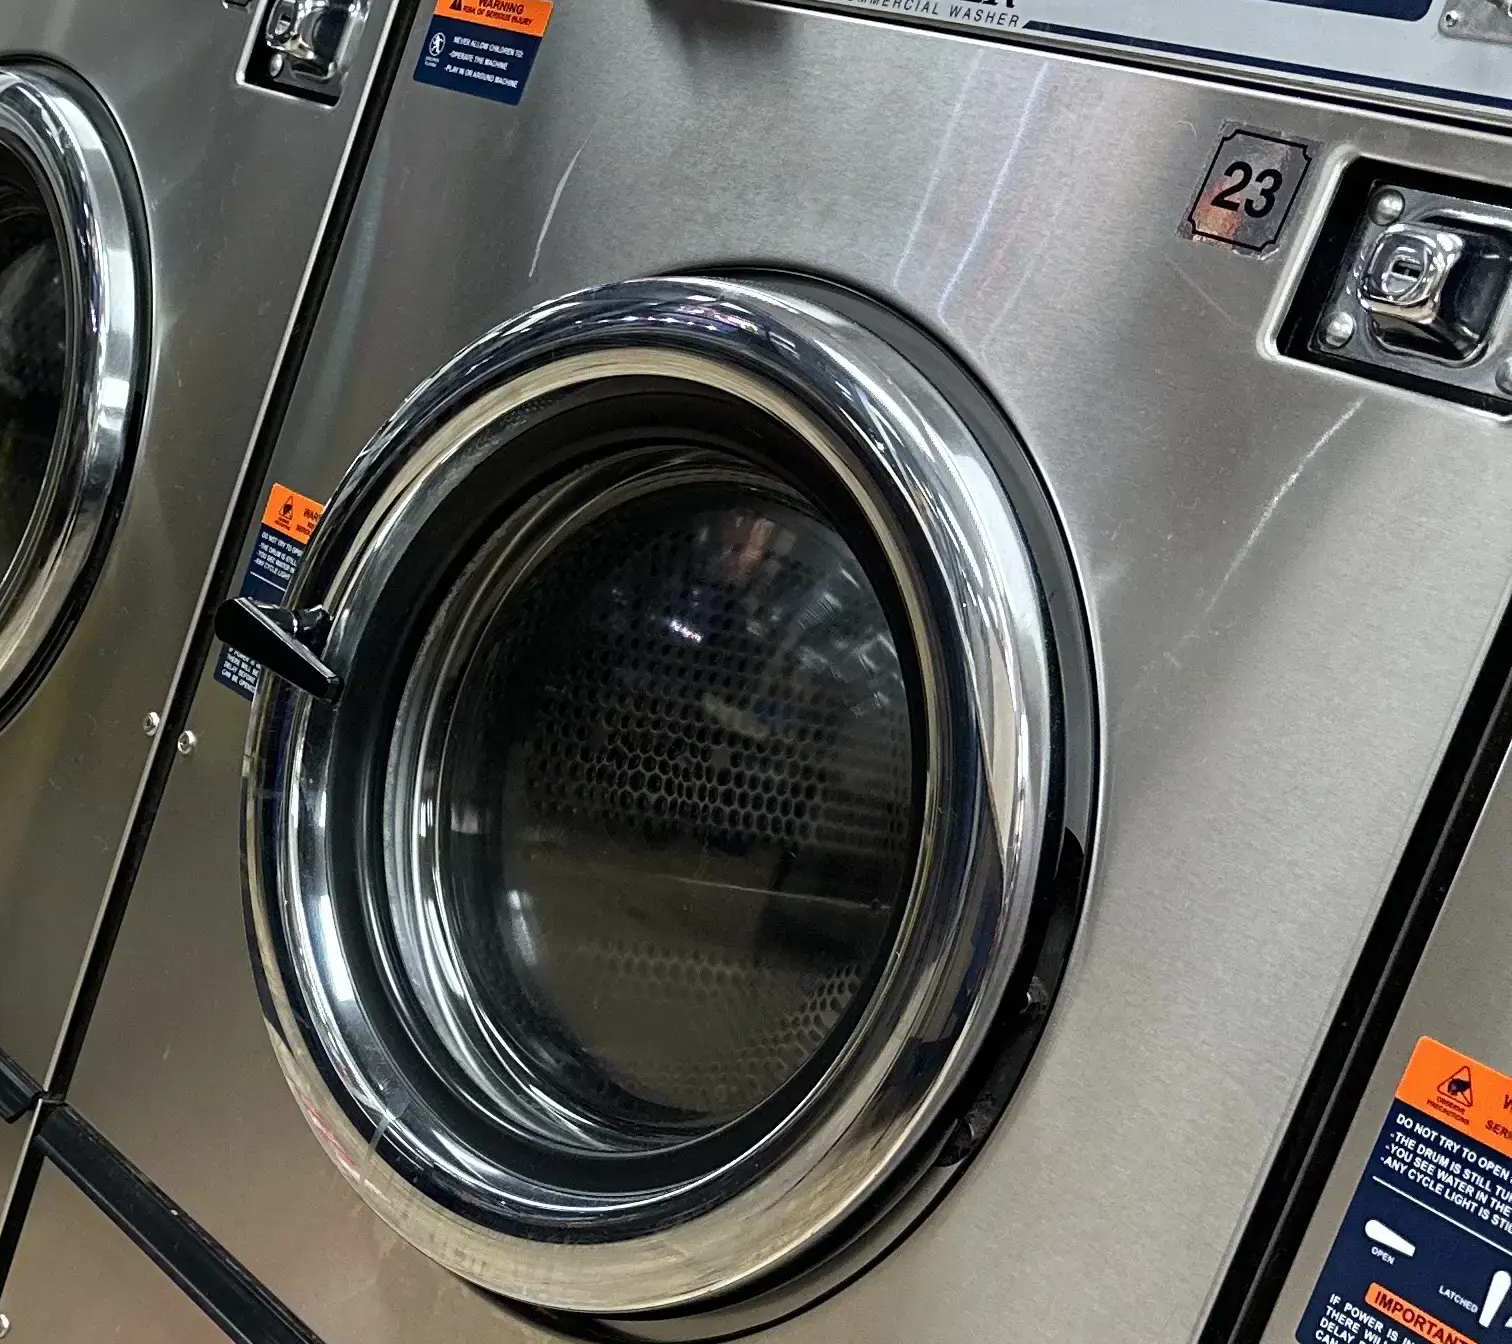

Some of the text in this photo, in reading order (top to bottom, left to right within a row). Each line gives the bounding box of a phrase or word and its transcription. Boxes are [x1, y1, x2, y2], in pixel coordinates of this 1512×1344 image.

[949, 5, 1020, 29] WASHER
[1210, 160, 1284, 219] 23
[1395, 1113, 1510, 1181] DO NOT TRY TO OPEN
[1416, 1144, 1450, 1168] DRUM
[1449, 1161, 1462, 1175] IS
[1462, 1168, 1492, 1193] STILL
[1407, 1168, 1445, 1196] CYCLE
[1443, 1188, 1479, 1213] LIGHT
[1477, 1206, 1491, 1221] IS
[1413, 1157, 1437, 1176] SEE
[1436, 1168, 1475, 1197] WATER
[1475, 1189, 1489, 1204] IN
[1371, 1246, 1395, 1265] OPEN
[1325, 1305, 1361, 1334] THERE
[1329, 1293, 1342, 1306] IF
[1343, 1301, 1384, 1333] POWER
[1386, 1328, 1399, 1342] IS
[1438, 1285, 1479, 1314] LATCHED
[1319, 1317, 1356, 1344] DELAY
